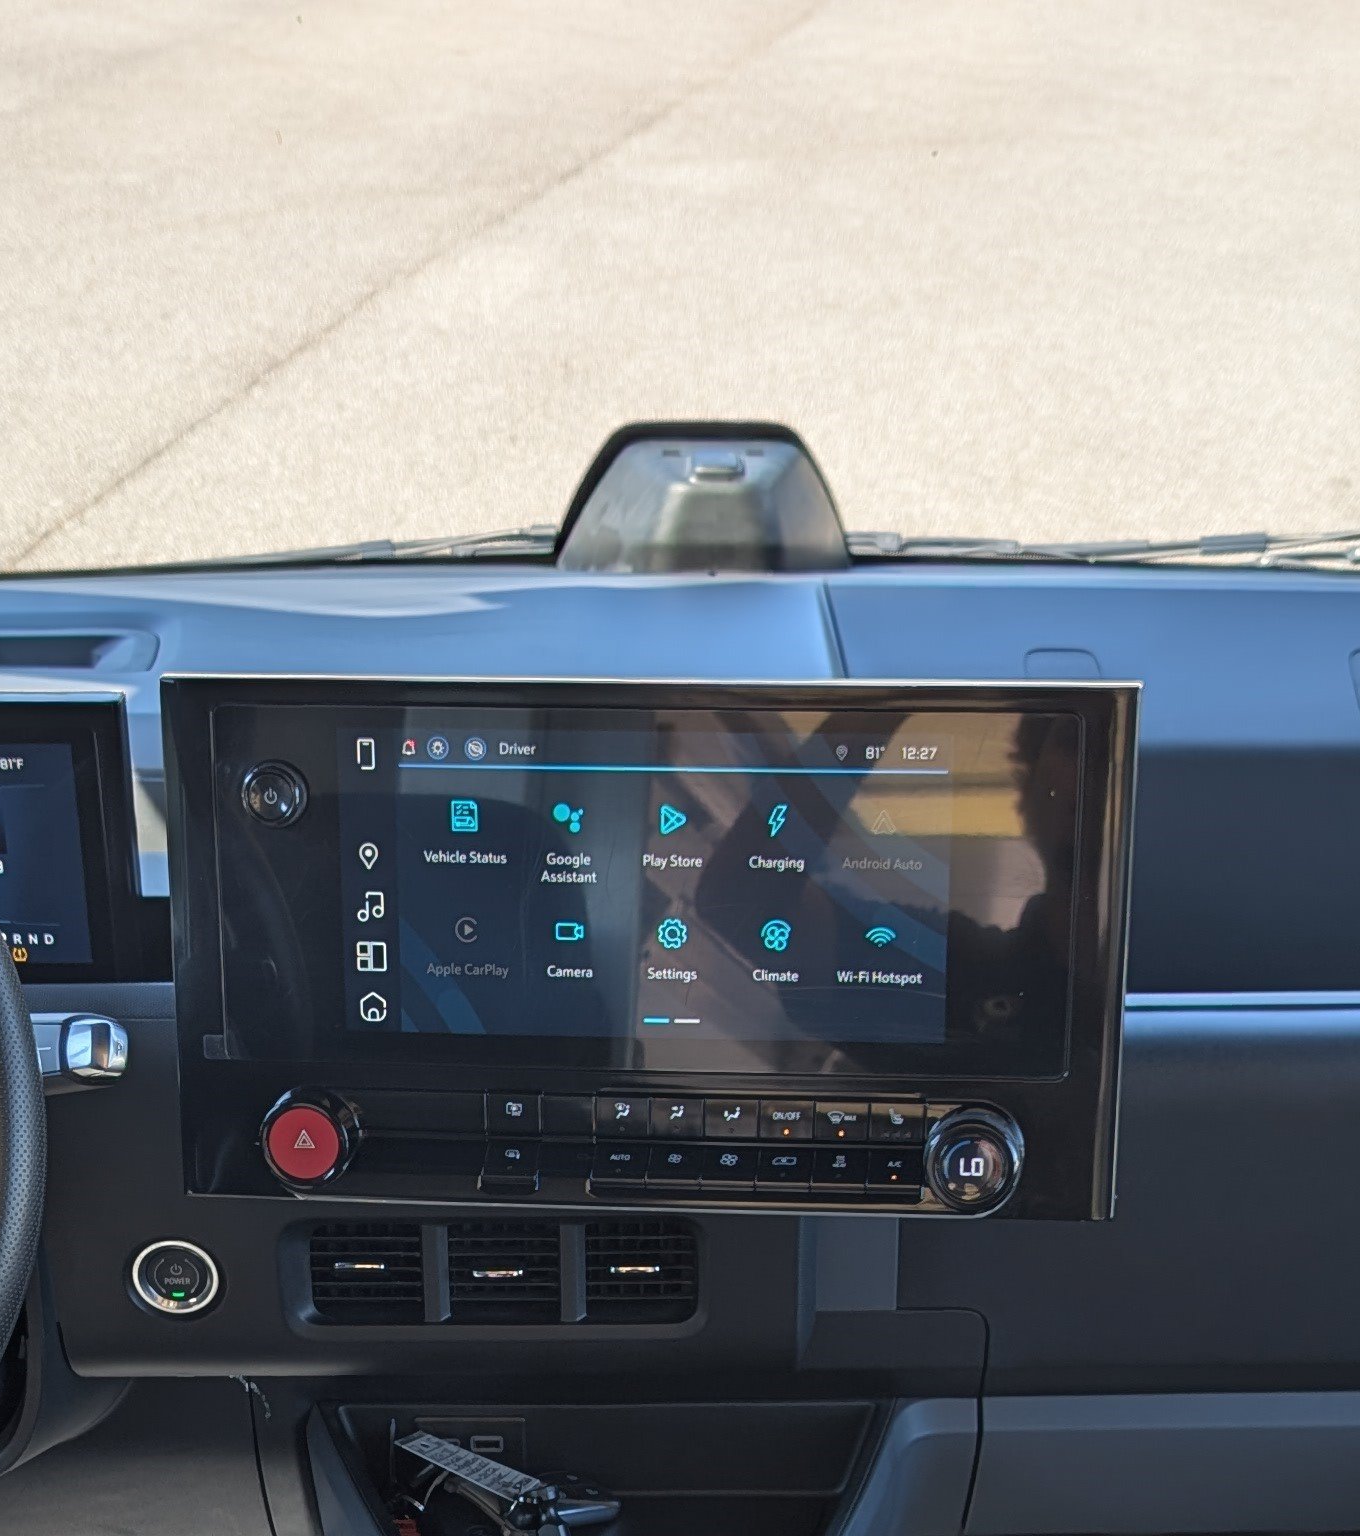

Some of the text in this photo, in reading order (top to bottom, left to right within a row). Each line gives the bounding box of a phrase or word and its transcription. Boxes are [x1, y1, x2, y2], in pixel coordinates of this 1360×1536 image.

[498, 742, 536, 756] Driver
[865, 745, 938, 760] 81° 12:27
[423, 850, 507, 865] Vehicle Status
[546, 853, 591, 868] Google
[642, 854, 703, 870] Play Store
[748, 856, 805, 872] Charging
[842, 857, 923, 871] Android Auto
[541, 870, 597, 884] Assistant
[426, 963, 509, 979] Apple CarPlay
[547, 965, 594, 978] Camera
[647, 967, 698, 983] Settings
[752, 969, 799, 982] Climate
[836, 970, 923, 986] Wi-Fi Hotspot
[772, 1111, 801, 1121] ON/OFF
[609, 1153, 631, 1161] AUTO
[959, 1157, 984, 1177] LO
[164, 1277, 191, 1285] POWER
